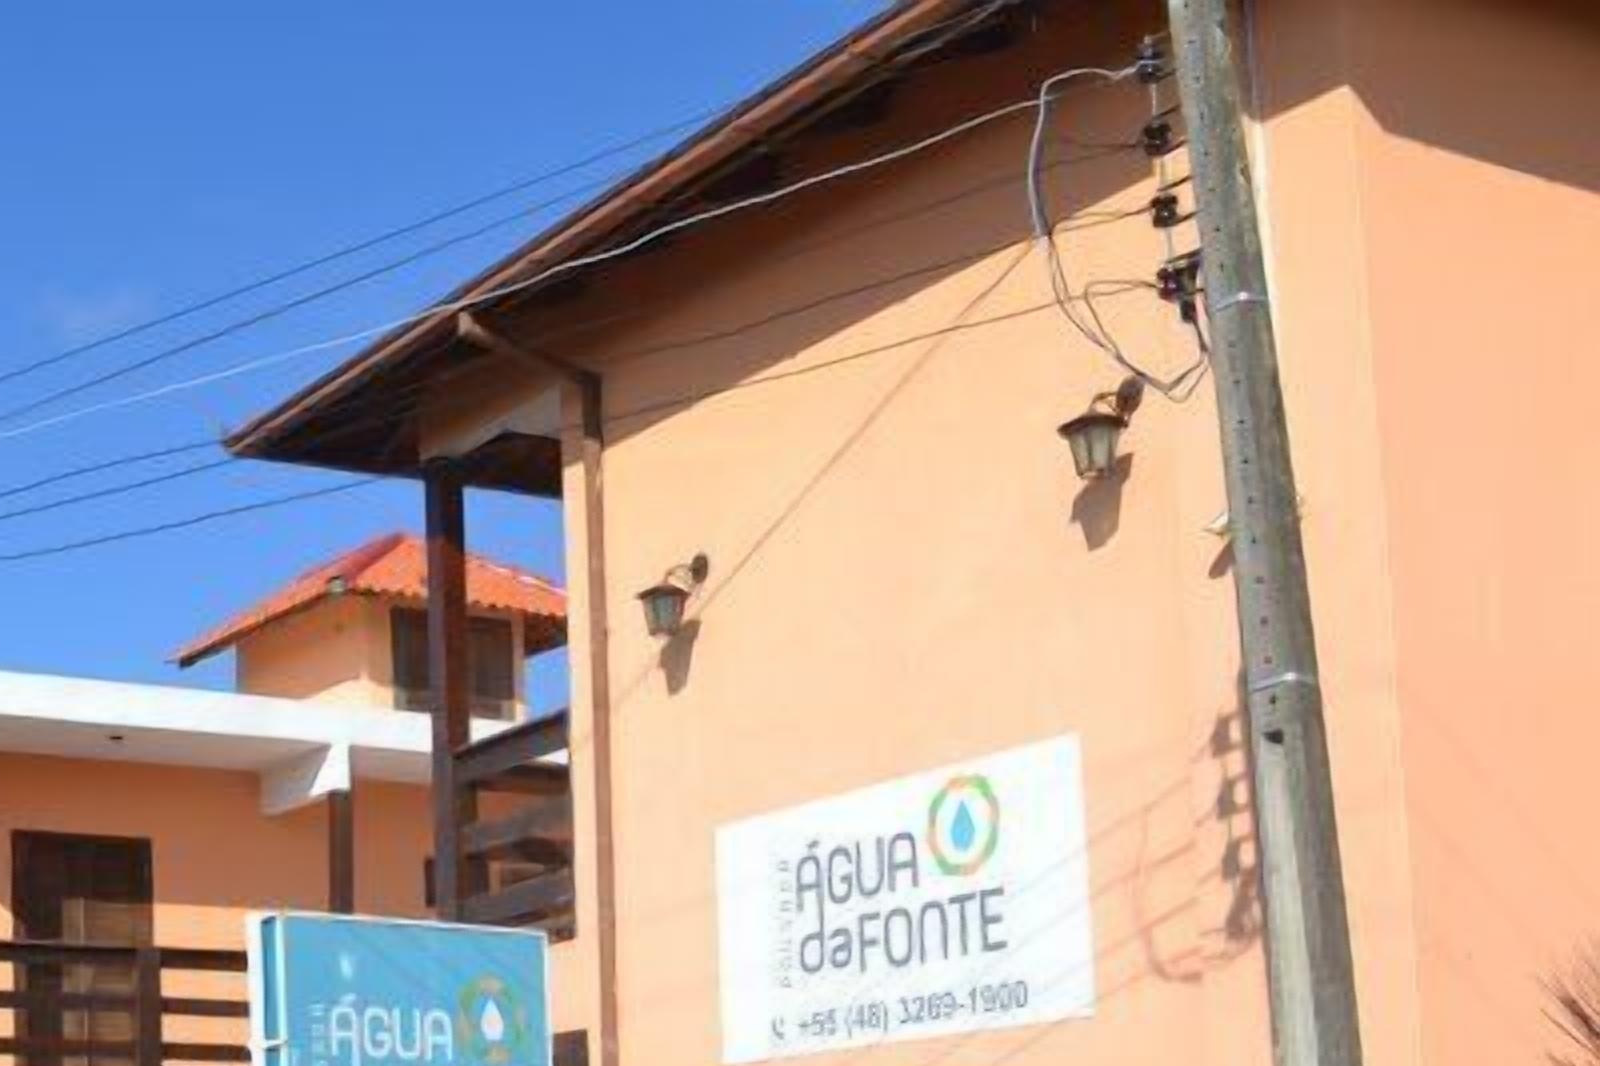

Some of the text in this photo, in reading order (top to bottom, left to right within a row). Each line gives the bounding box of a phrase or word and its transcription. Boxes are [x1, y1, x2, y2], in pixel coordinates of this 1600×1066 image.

[795, 832, 919, 913] ÁGUA
[330, 993, 454, 1061] ÁGUA
[845, 1001, 888, 1038] (48)
